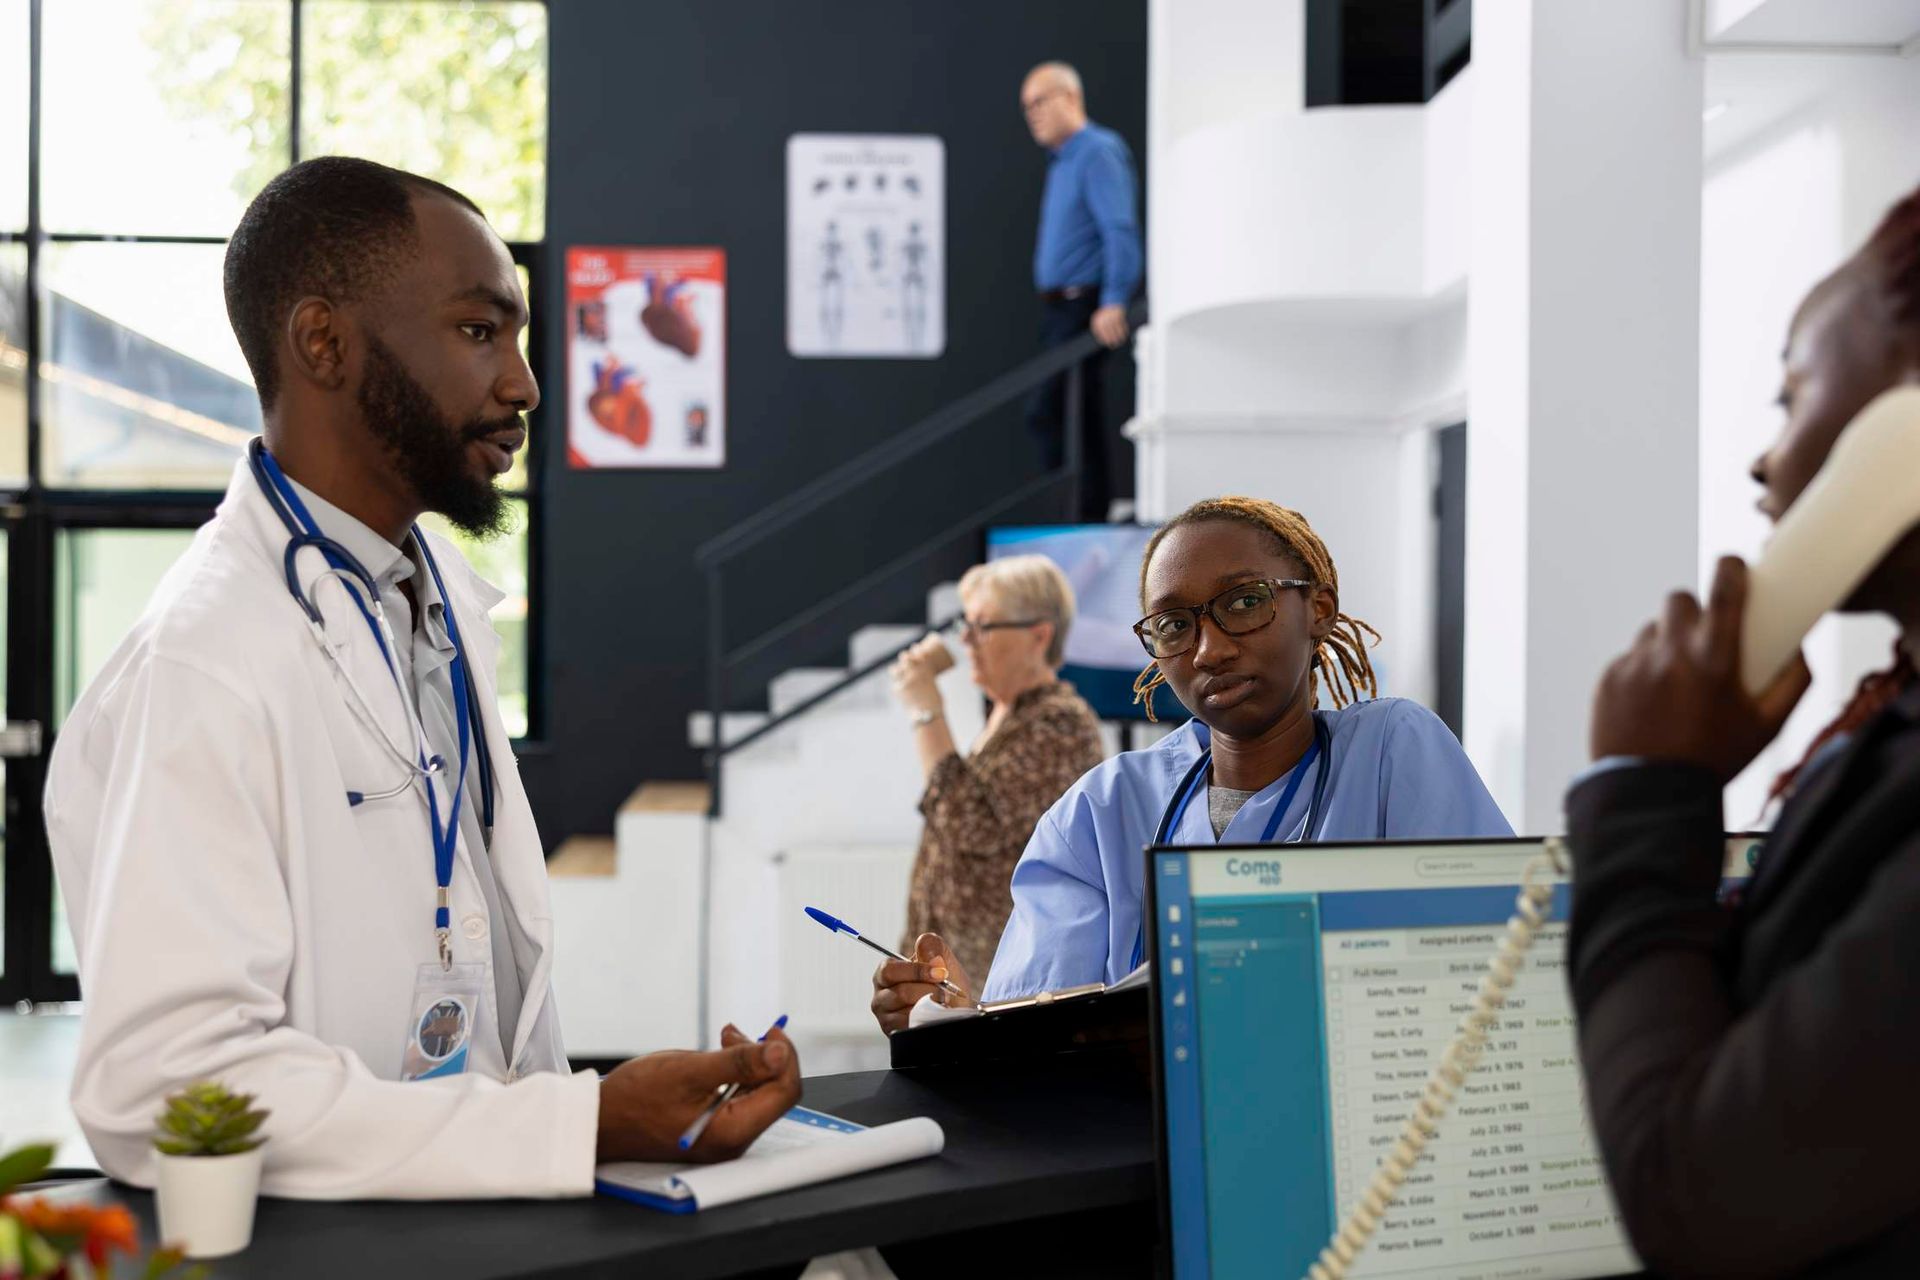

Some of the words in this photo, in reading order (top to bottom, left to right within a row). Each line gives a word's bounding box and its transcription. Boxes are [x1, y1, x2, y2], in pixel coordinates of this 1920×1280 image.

[1226, 857, 1281, 876] Come
[1354, 939, 1390, 950] patients
[1420, 935, 1458, 948] Assigned
[1460, 933, 1494, 946] patients
[1353, 967, 1370, 977] Full
[1372, 967, 1398, 976] Name
[1449, 963, 1469, 974] Birth
[1464, 1084, 1490, 1095] March
[1458, 1105, 1496, 1117] February
[1469, 1127, 1486, 1138] July
[1470, 1147, 1487, 1158] July
[1467, 1167, 1497, 1179] August
[1469, 1188, 1495, 1199] March
[1462, 1209, 1505, 1222] November
[1468, 1230, 1504, 1243] October
